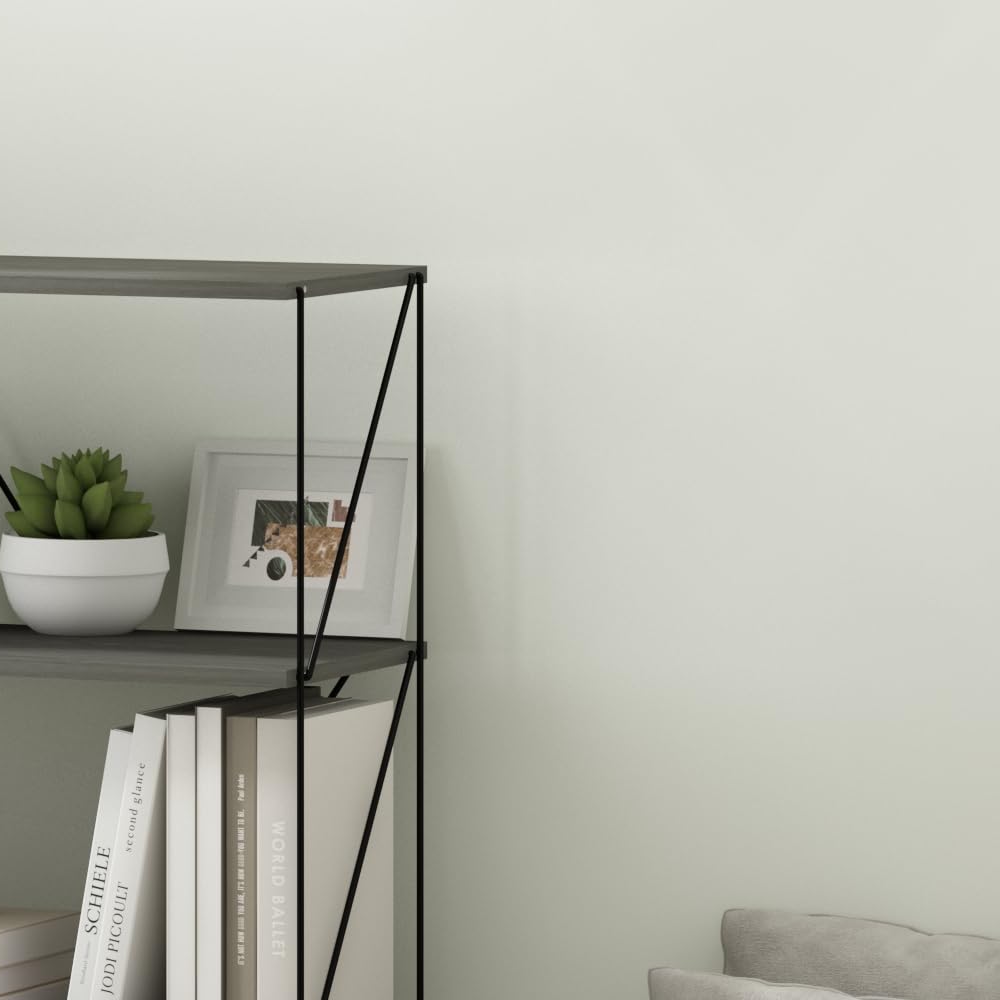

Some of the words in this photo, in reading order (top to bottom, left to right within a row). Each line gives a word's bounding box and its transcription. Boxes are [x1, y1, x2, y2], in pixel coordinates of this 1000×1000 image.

[124, 808, 138, 853] second
[131, 761, 146, 805] glance
[271, 820, 286, 887] WORLD
[84, 846, 111, 936] SCHIELE
[107, 880, 129, 953] PICOULT
[271, 895, 286, 959] BALLET
[100, 957, 117, 996] JODI
